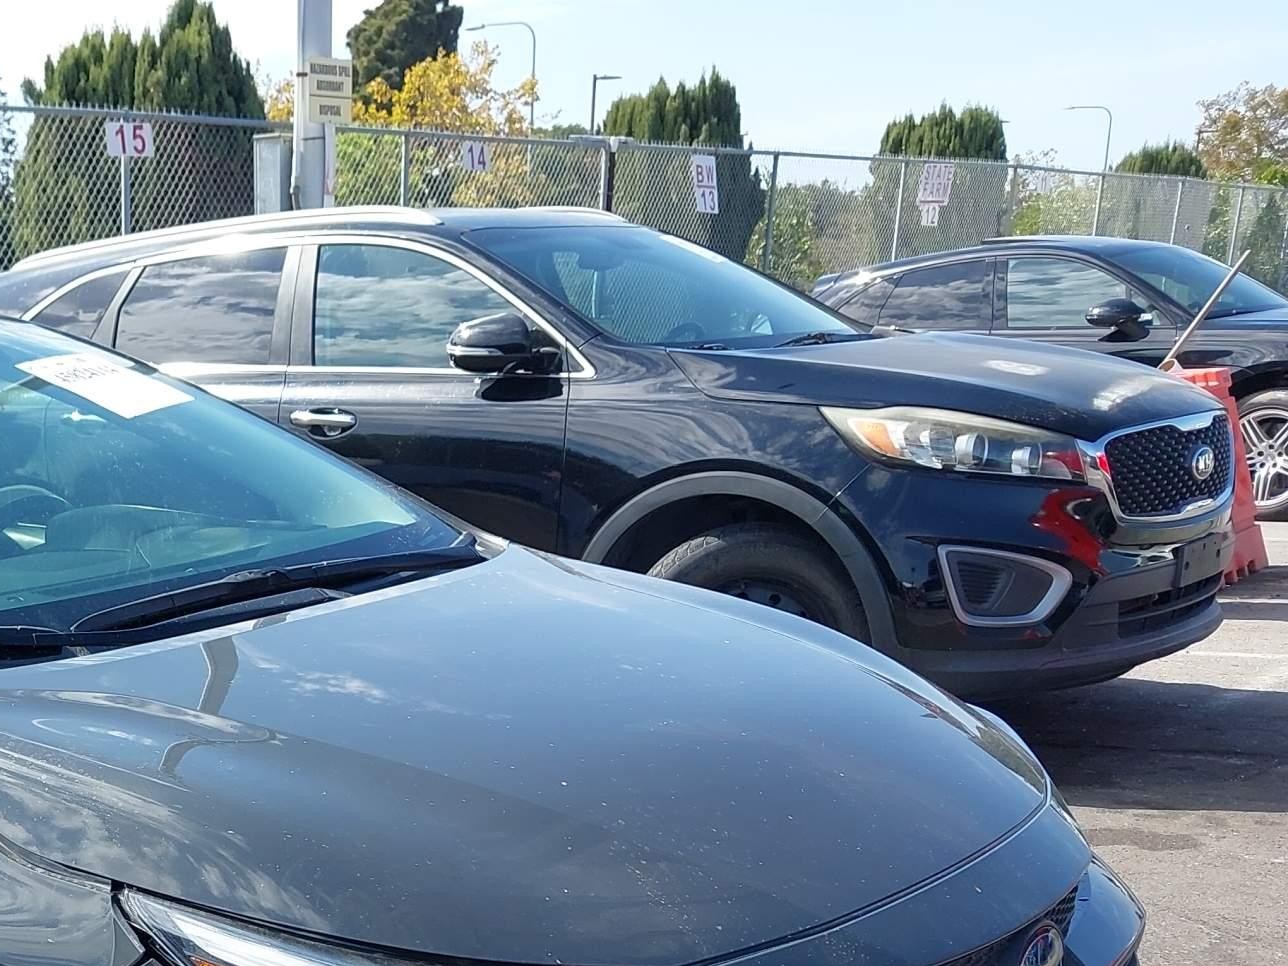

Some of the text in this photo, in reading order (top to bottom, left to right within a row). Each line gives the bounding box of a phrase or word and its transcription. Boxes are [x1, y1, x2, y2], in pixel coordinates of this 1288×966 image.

[115, 124, 146, 155] 15
[468, 143, 486, 170] 14
[696, 165, 714, 184] BW
[925, 165, 953, 181] STATE
[921, 181, 950, 198] FARM
[701, 190, 716, 211] 13
[925, 206, 937, 225] 12
